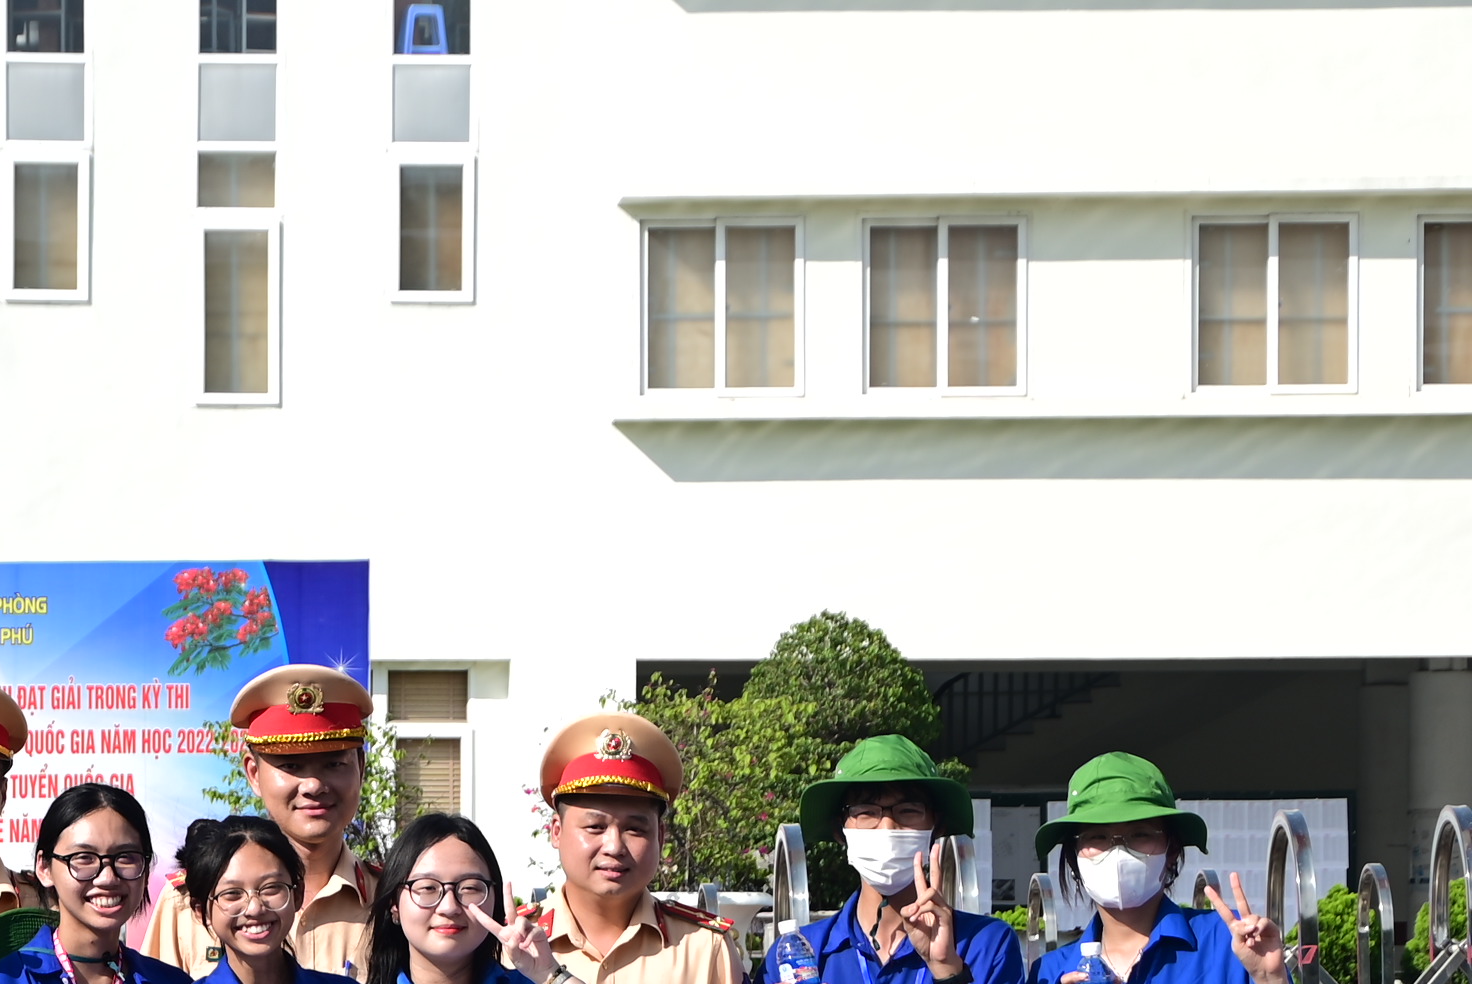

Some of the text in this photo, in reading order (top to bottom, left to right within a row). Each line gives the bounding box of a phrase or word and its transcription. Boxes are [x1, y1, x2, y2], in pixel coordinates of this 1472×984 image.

[0, 623, 33, 646] PHÚ
[17, 685, 46, 716] ĐẠT
[51, 676, 81, 710] GIẢI
[86, 684, 137, 710] TRONG
[141, 678, 163, 709] KỲ
[166, 684, 190, 709] THI
[24, 720, 65, 757] QUỐC
[70, 729, 95, 754] GIA
[101, 724, 136, 754] NĂM
[142, 729, 173, 759] HỌC
[10, 764, 59, 798] TUYỂN
